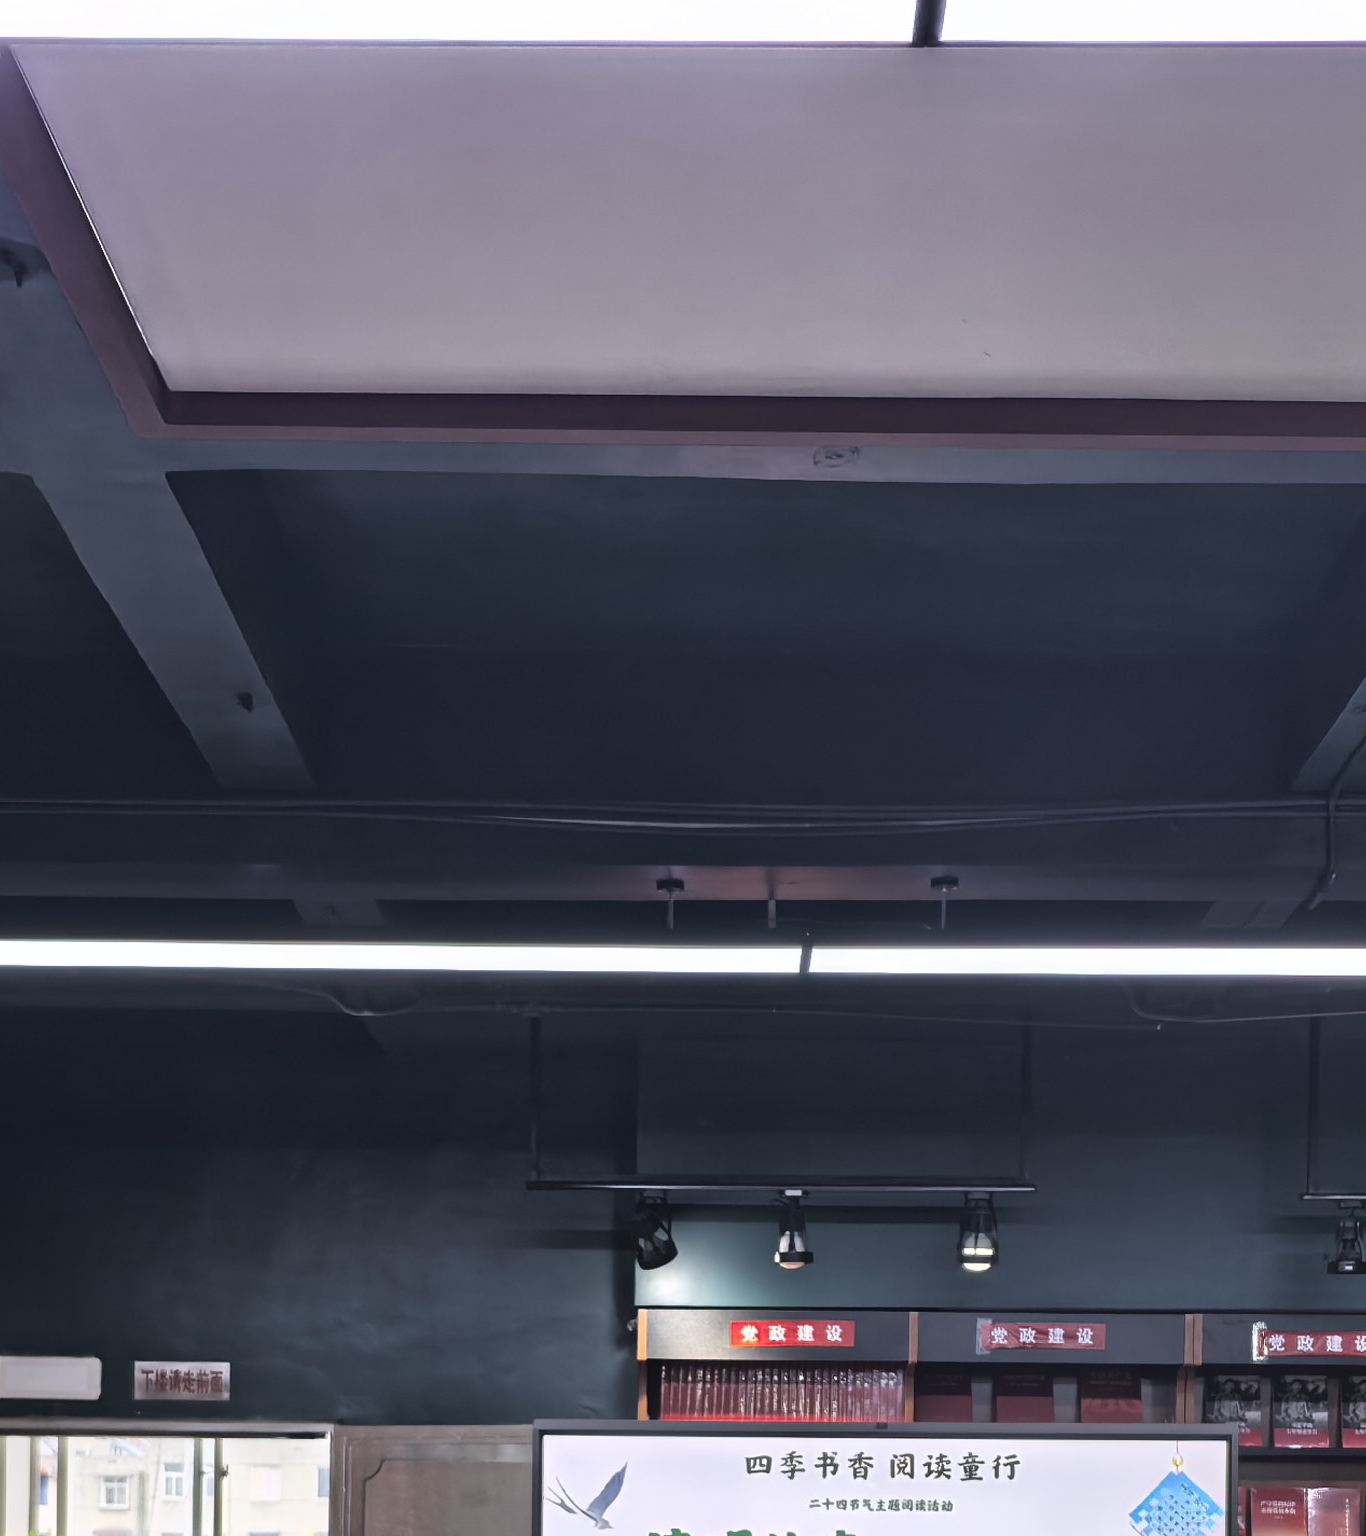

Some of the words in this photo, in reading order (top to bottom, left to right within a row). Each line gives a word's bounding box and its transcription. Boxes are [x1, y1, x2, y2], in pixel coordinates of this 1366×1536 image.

[741, 1325, 843, 1343] 党政建设
[991, 1327, 1094, 1344] 党政建设
[744, 1451, 875, 1480] 四季书香
[889, 1452, 1022, 1481] 阅读童行
[808, 1498, 955, 1513] 二十四节气主题阅读活动
